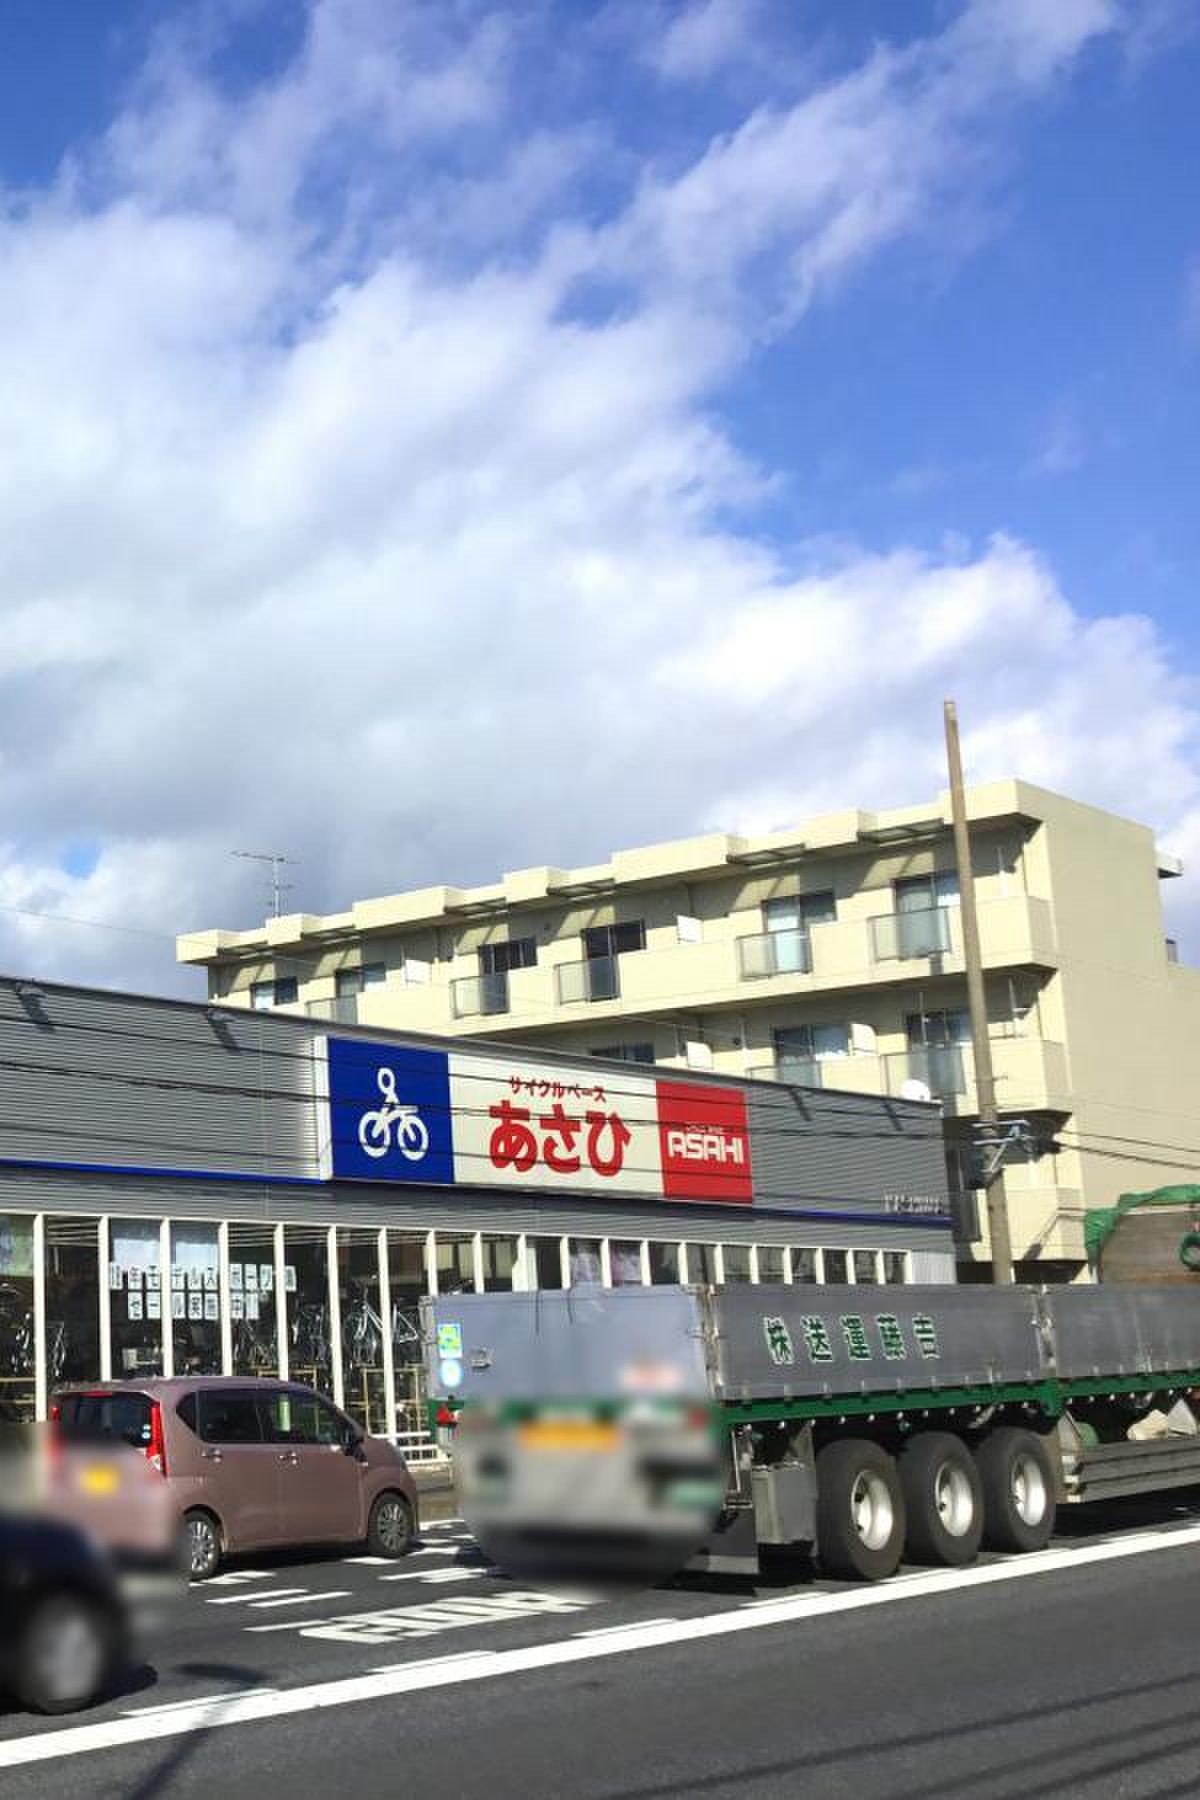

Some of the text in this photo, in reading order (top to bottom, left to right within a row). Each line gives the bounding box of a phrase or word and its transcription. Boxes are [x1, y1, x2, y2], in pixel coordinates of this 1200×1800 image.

[488, 1100, 632, 1177] あさひ
[667, 1131, 744, 1164] ASAHI
